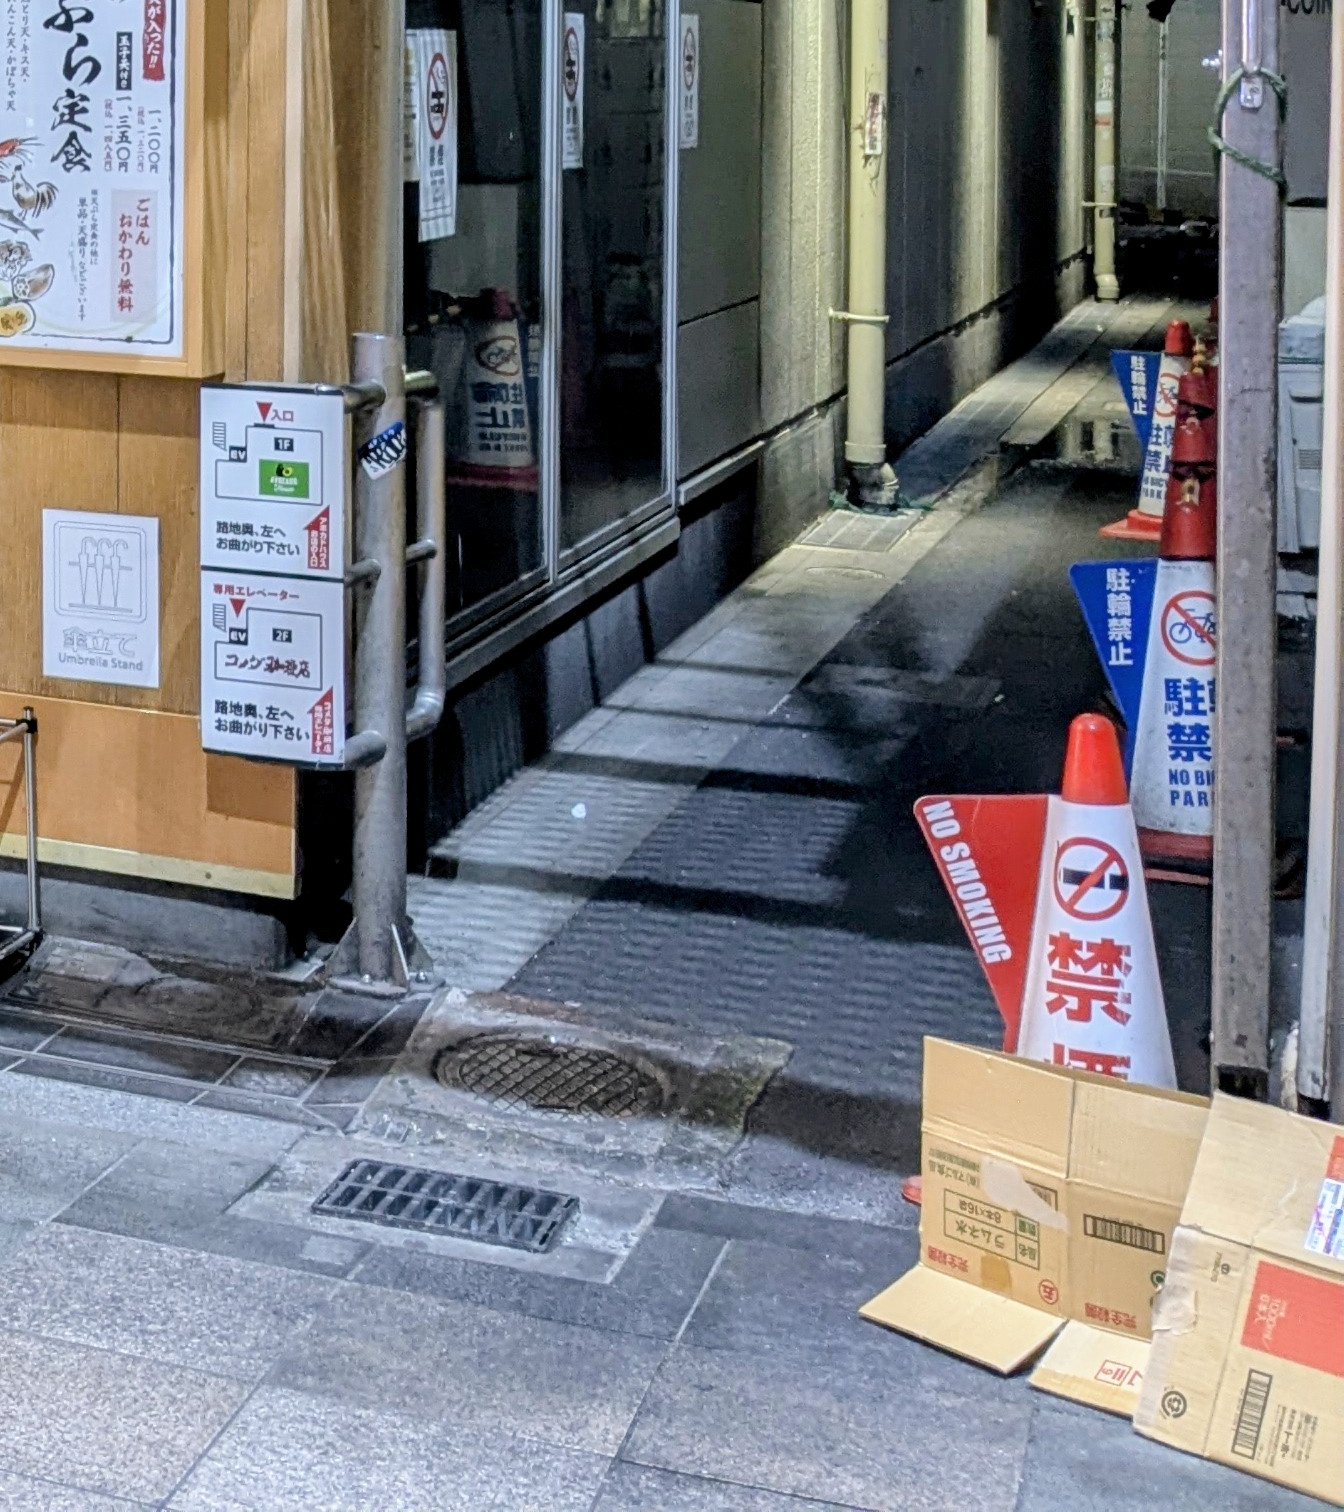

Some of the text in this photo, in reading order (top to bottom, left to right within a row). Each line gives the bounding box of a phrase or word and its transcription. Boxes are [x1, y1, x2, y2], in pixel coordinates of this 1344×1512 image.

[135, 198, 150, 246] ごはん
[118, 214, 133, 312] おかわり無料
[271, 409, 294, 422] 入口
[277, 439, 291, 449] 1F
[216, 521, 286, 538] 路地奥、左へ
[216, 537, 300, 555] お曲がり下さい
[213, 583, 300, 600] 専用エレベーター
[1106, 567, 1133, 666] 駐輪禁止
[275, 632, 289, 642] 2F
[58, 653, 144, 671] Umbrella Stand
[1164, 678, 1216, 717] 駐
[214, 699, 294, 721] 路地奥、左へ
[214, 717, 310, 742] お曲がり下さい
[1168, 769, 1190, 786] NO
[1170, 790, 1216, 807] PAR
[923, 800, 1012, 964] NO SMOKING
[955, 1219, 1005, 1249] ラムネ水
